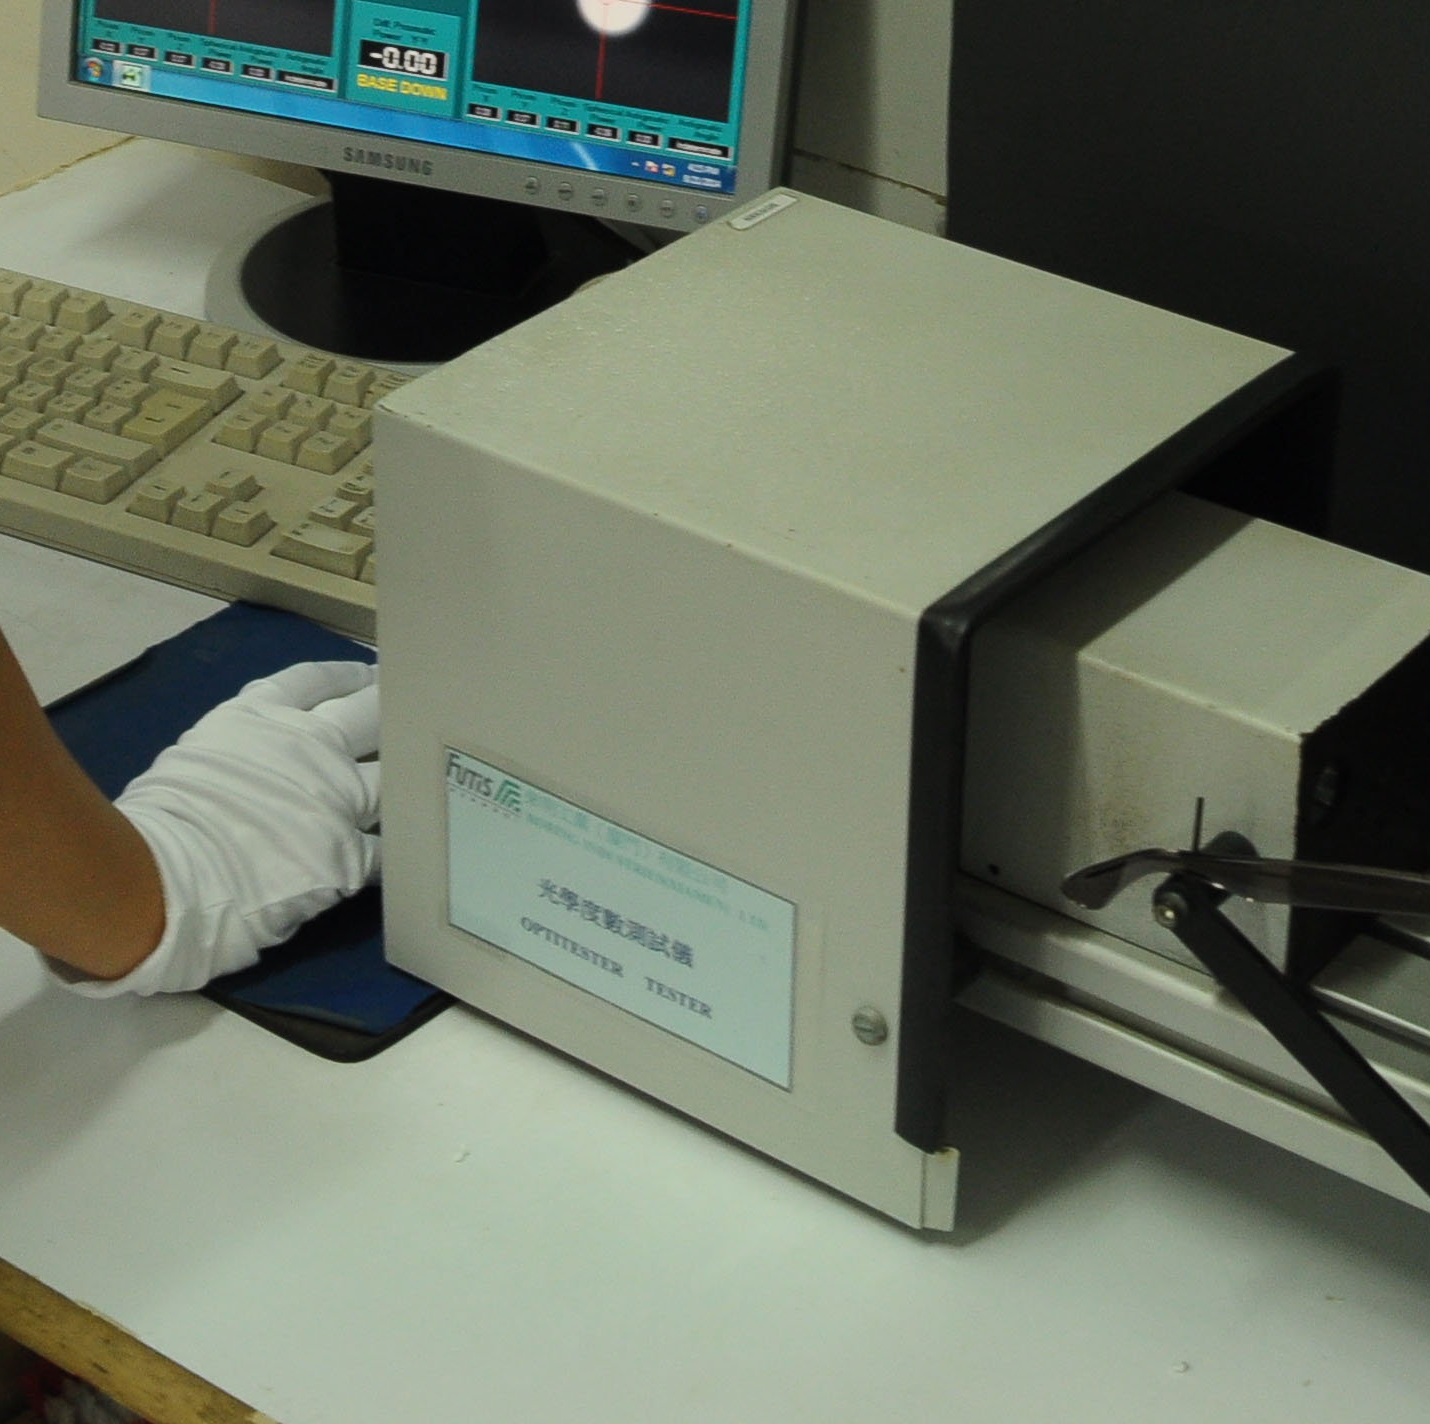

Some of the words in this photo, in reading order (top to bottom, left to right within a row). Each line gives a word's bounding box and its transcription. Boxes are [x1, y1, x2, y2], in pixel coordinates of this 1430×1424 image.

[369, 46, 438, 75] -0.00
[356, 73, 399, 93] BASE
[400, 79, 448, 101] DOWN
[342, 146, 434, 177] SAMSUNG
[520, 916, 625, 977] OPTITESTER
[644, 977, 713, 1020] TESTER
